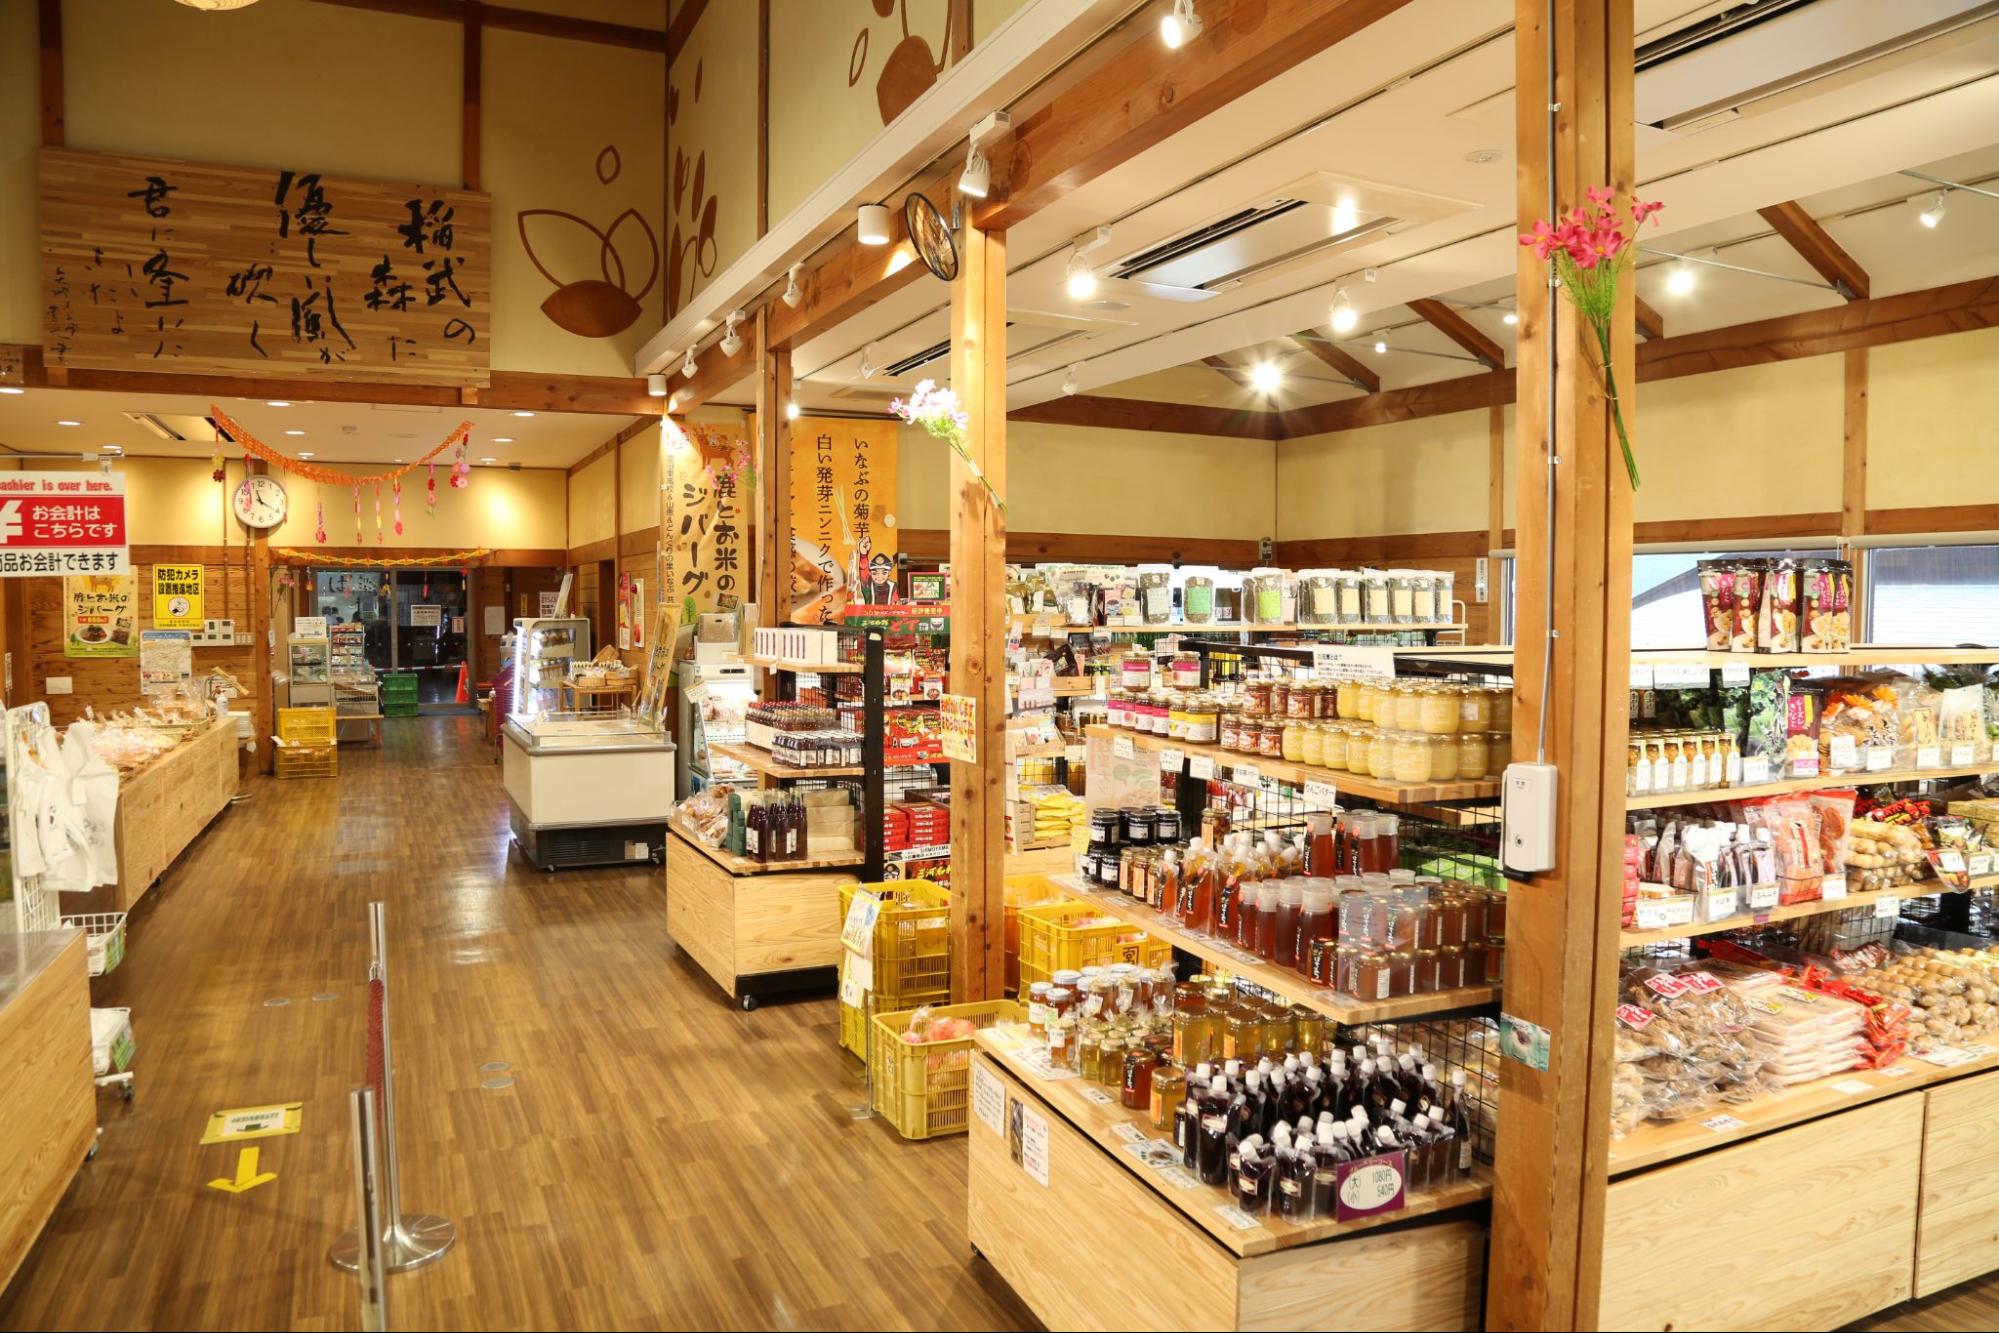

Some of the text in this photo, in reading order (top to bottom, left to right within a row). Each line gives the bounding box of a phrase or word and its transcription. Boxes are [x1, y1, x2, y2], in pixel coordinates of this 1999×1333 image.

[41, 480, 54, 492] is
[58, 482, 82, 492] over
[86, 480, 113, 492] here.
[853, 438, 870, 539] いなぶの菊芋
[32, 505, 101, 521] お会計は
[34, 523, 118, 538] こちらです
[713, 474, 740, 591] 鹿とお米の
[816, 433, 834, 626] 白い発芽ニンニクで作った
[681, 483, 709, 596] ジバーグ
[0, 551, 119, 573] 品お会計できます
[157, 568, 200, 582] 防犯カメラ
[77, 604, 127, 615] ジバーグ
